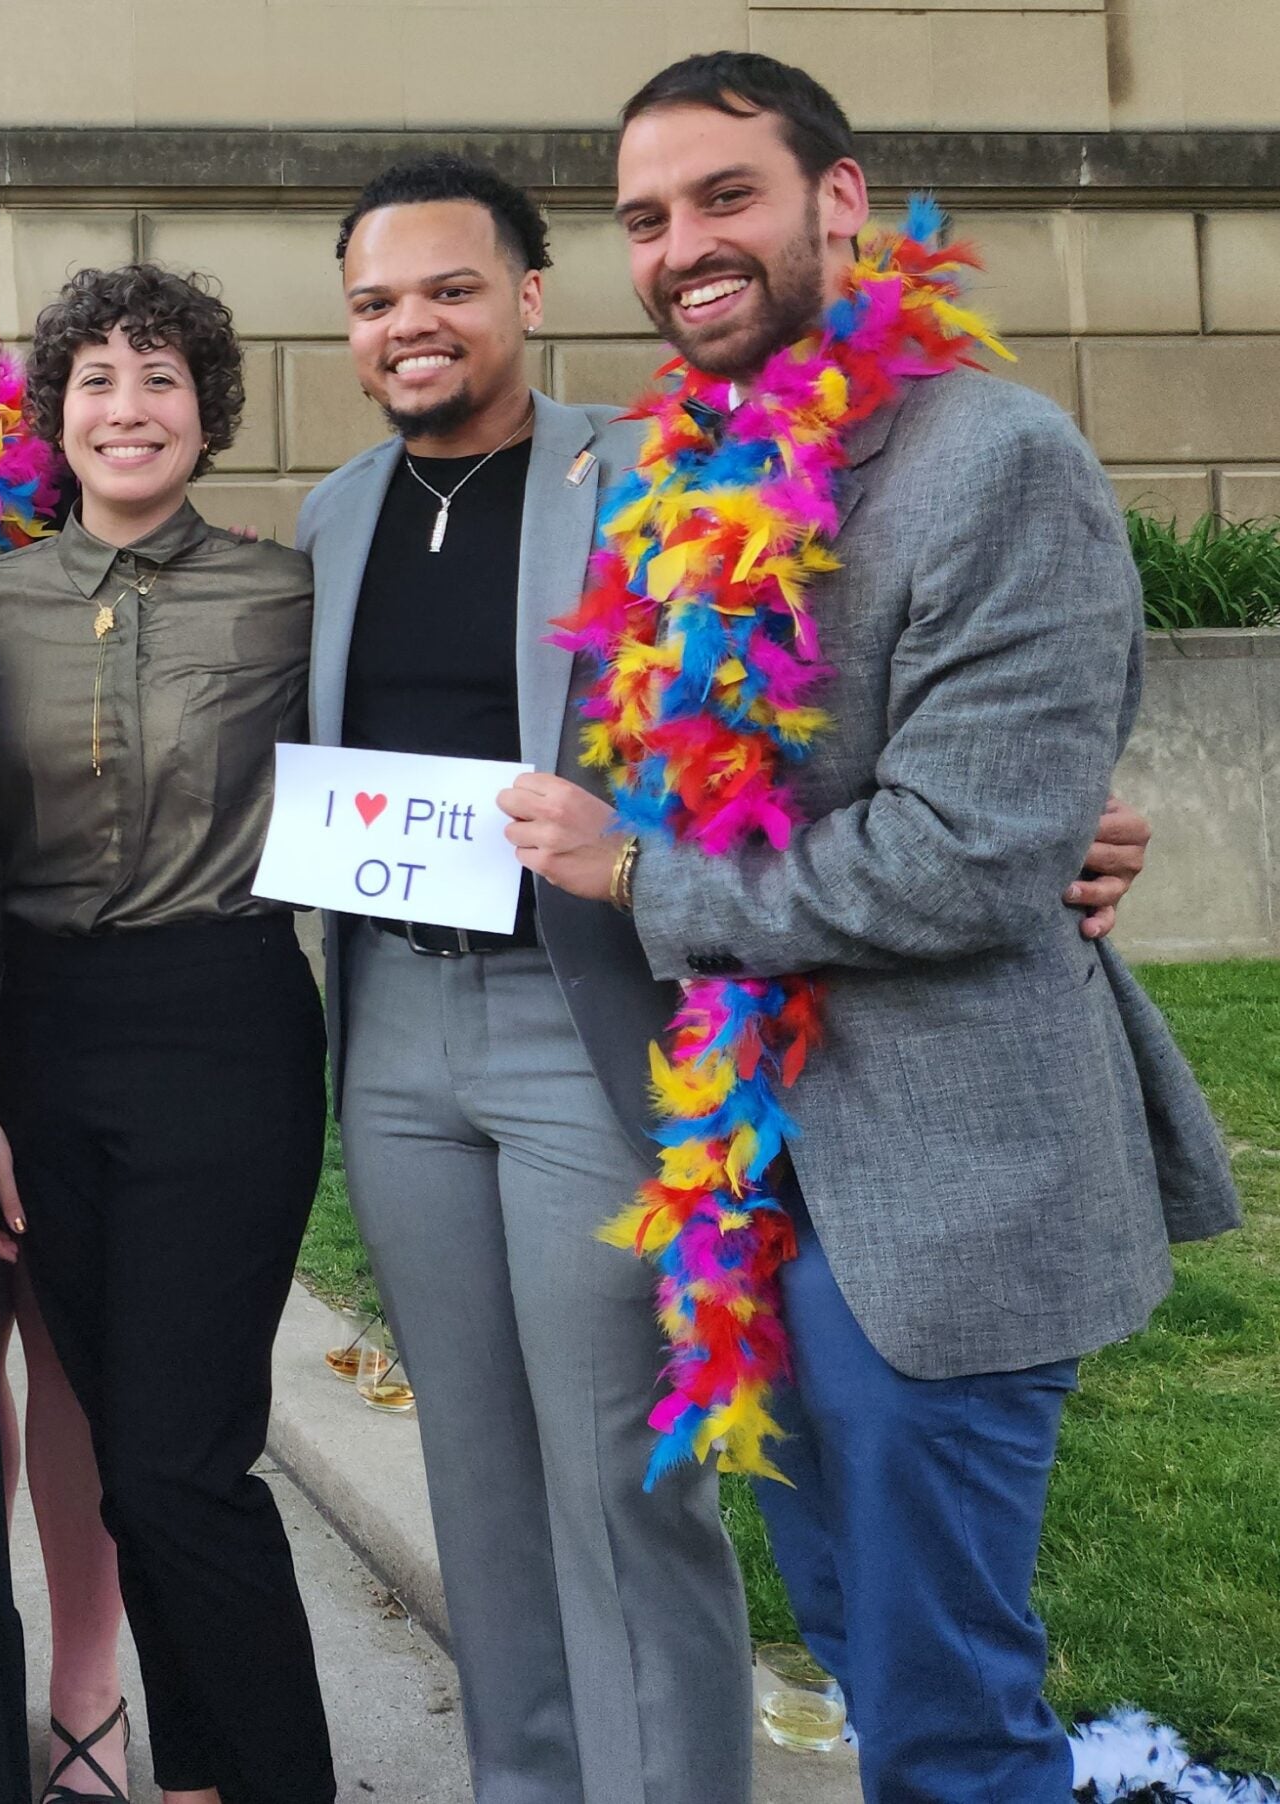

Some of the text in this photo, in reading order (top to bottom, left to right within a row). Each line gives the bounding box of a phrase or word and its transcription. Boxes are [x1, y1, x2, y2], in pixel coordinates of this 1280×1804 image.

[325, 790, 476, 841] I Pitt
[355, 859, 426, 901] OT
